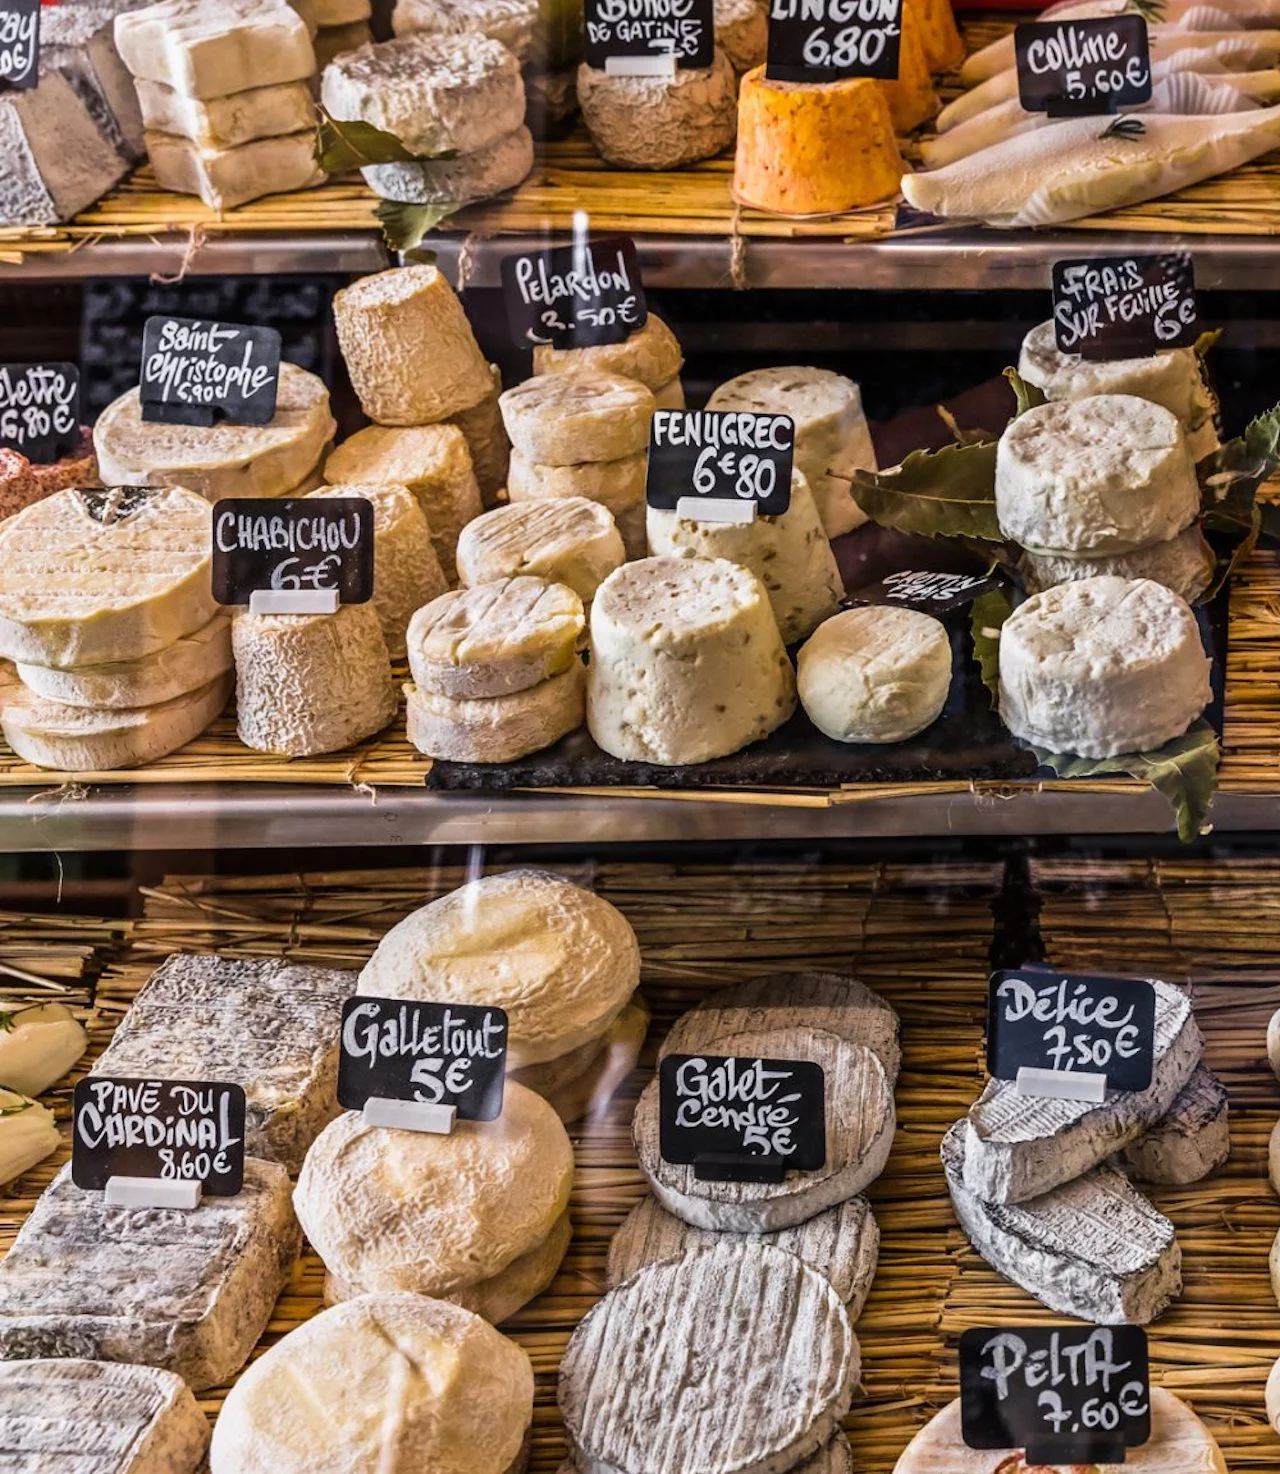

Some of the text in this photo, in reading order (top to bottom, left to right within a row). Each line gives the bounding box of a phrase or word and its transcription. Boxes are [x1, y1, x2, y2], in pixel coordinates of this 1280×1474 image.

[803, 23, 901, 68] 6,80€
[159, 320, 240, 352] Saint
[1055, 300, 1104, 347] SUR
[1154, 298, 1197, 340] 6€
[1, 404, 75, 444] 6,80€
[654, 411, 792, 451] FENUGREC
[270, 554, 342, 590] 6€
[997, 979, 1135, 1028] Délice
[1043, 1025, 1142, 1071] 7,50€
[169, 1086, 214, 1115] DU
[410, 1057, 473, 1104] 5€
[676, 1057, 794, 1106] Galet
[675, 1093, 802, 1132] Cendré
[742, 1125, 798, 1156] 5€
[158, 1148, 232, 1180] 8,60€
